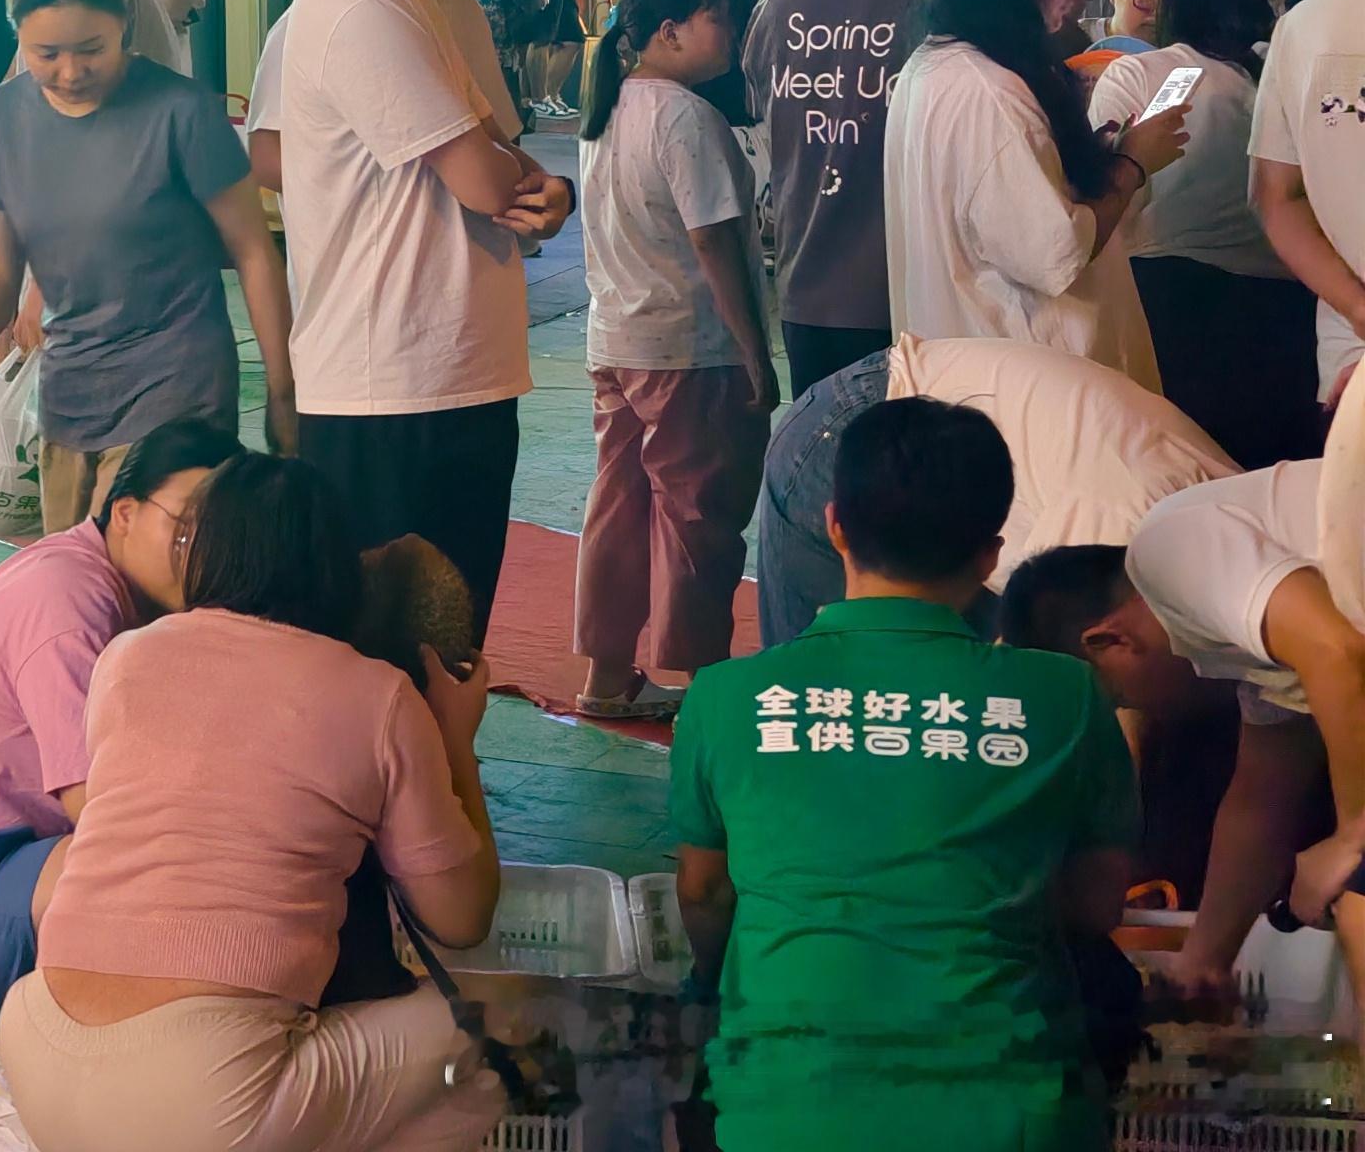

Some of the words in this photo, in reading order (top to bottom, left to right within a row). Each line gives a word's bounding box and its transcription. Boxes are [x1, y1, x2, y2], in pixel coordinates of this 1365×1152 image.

[787, 12, 896, 58] Spring
[772, 64, 845, 99] Meet
[806, 110, 859, 145] Run
[754, 684, 1027, 731] 全球好水果
[755, 720, 1029, 767] 直供百果园
